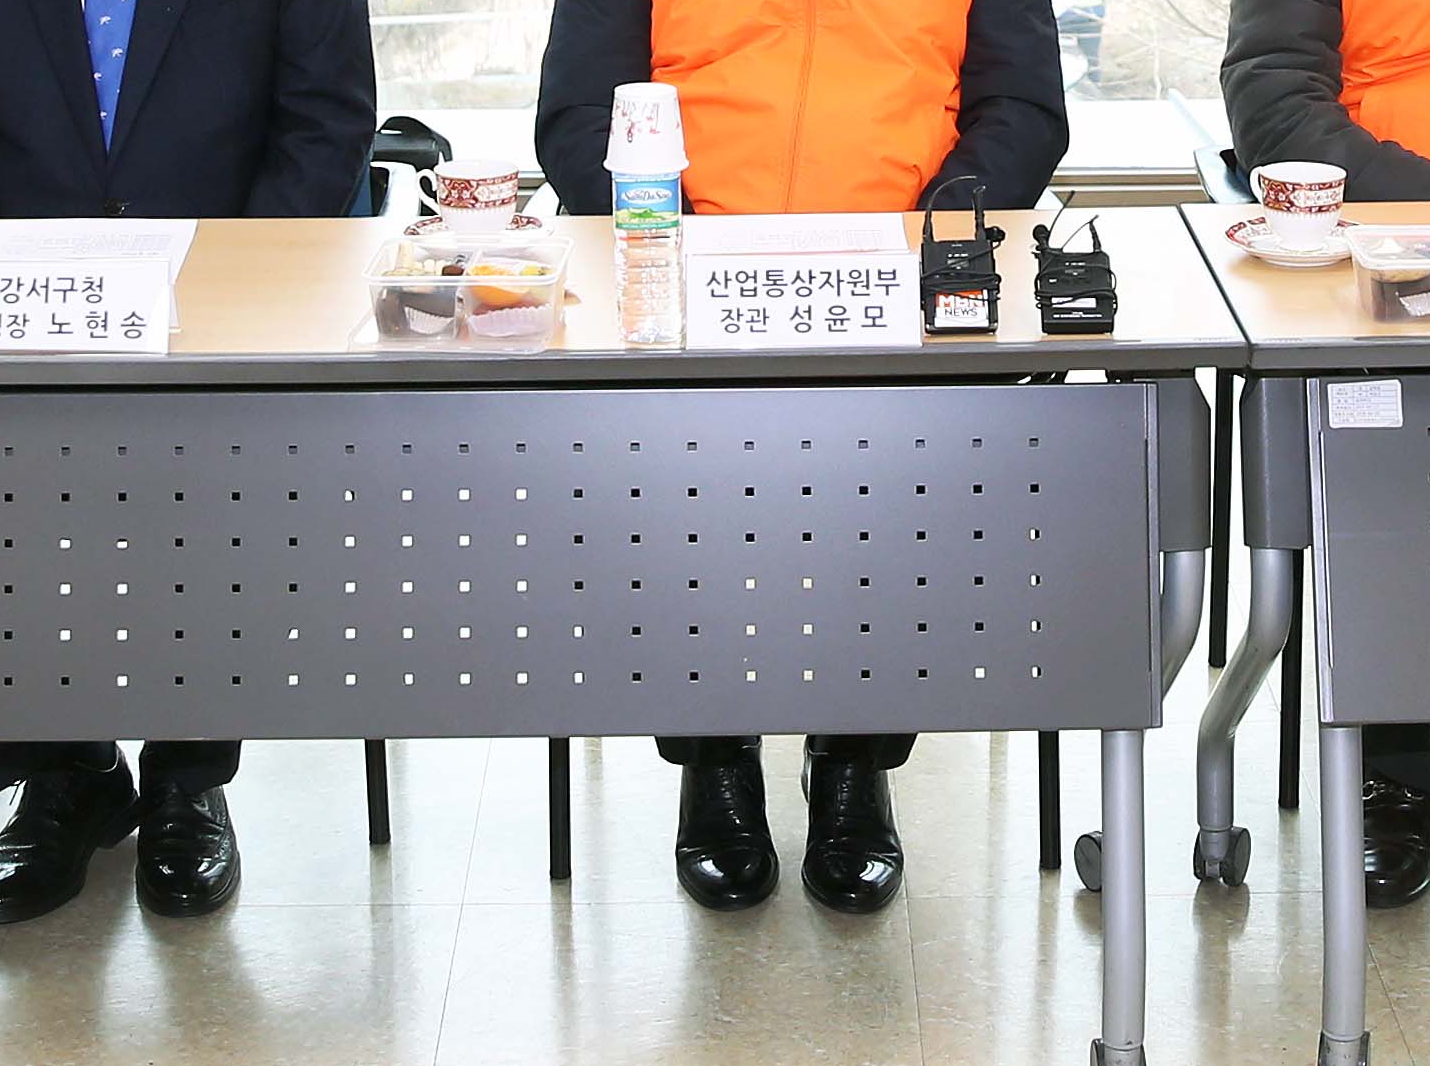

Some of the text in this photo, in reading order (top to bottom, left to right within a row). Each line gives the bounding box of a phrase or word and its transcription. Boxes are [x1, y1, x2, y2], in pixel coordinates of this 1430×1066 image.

[0, 277, 103, 303] 강서구청
[707, 269, 900, 298] 산업통상자원부
[721, 308, 769, 333] 장관
[944, 308, 978, 317] NEWS
